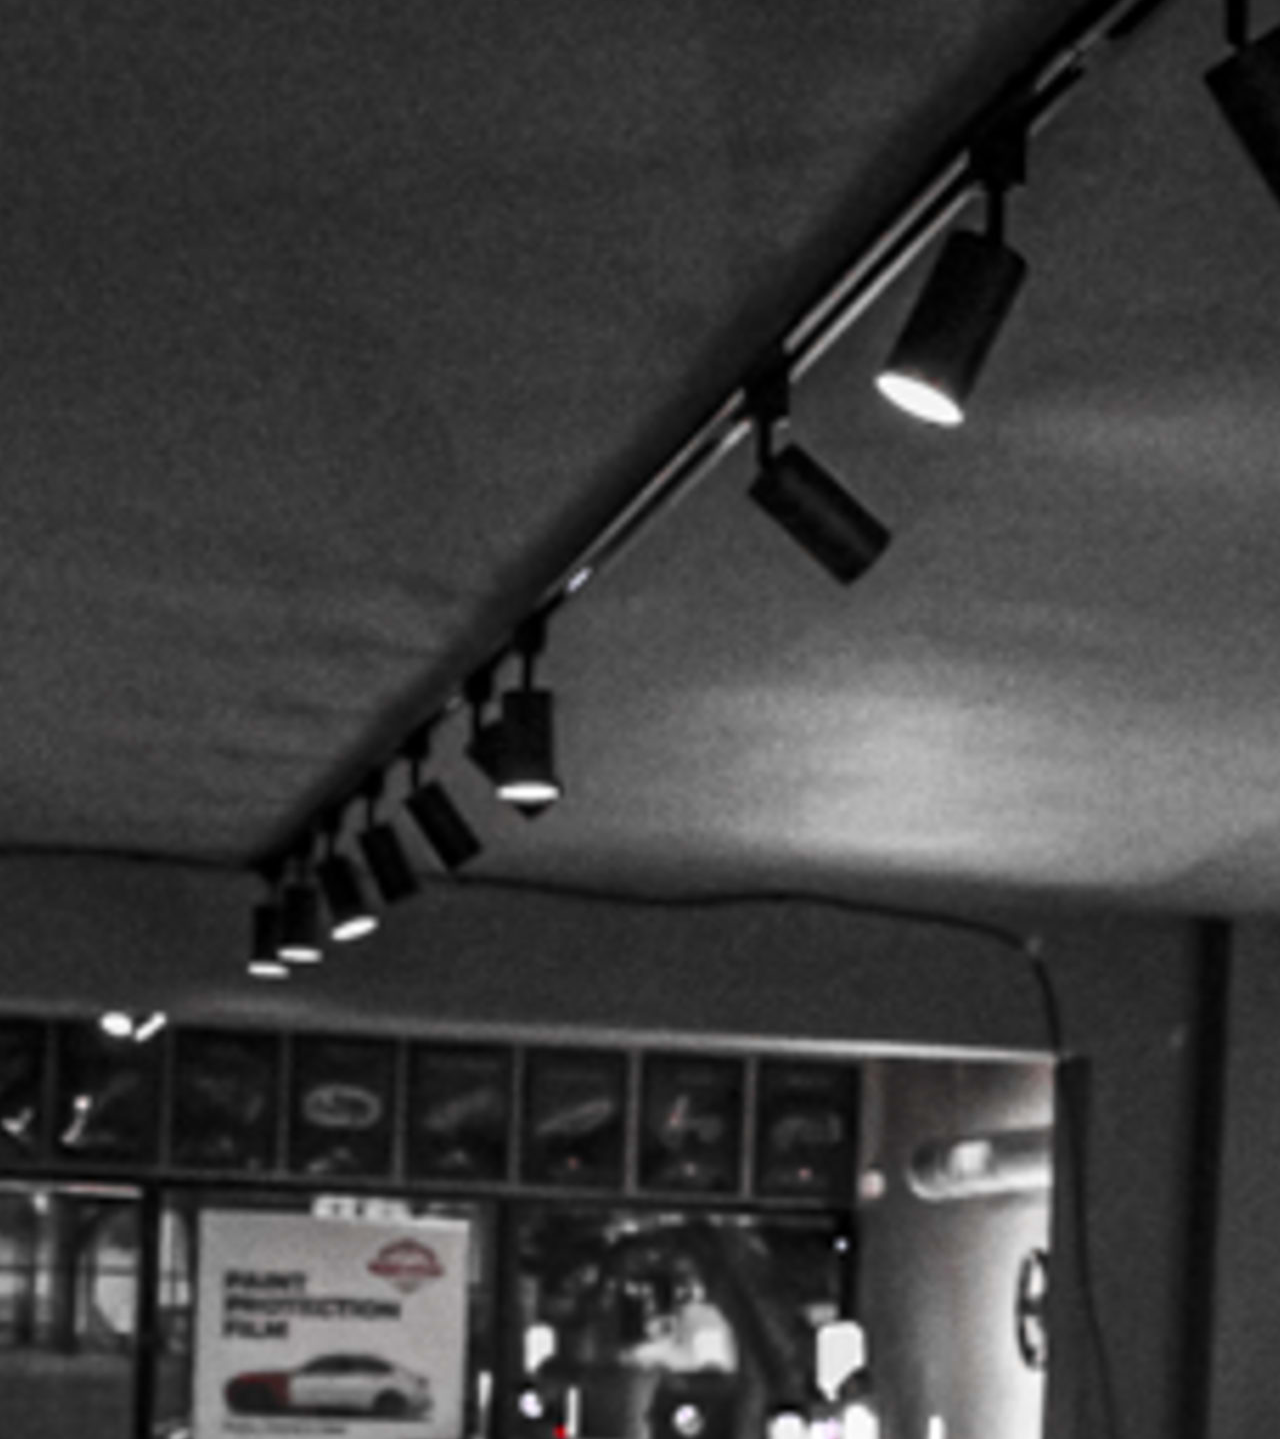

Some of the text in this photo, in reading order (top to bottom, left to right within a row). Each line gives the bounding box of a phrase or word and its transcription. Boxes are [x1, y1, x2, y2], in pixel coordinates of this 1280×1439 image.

[225, 1272, 305, 1289] PAINT
[225, 1297, 401, 1318] PROTECTION
[224, 1321, 288, 1338] FILM
